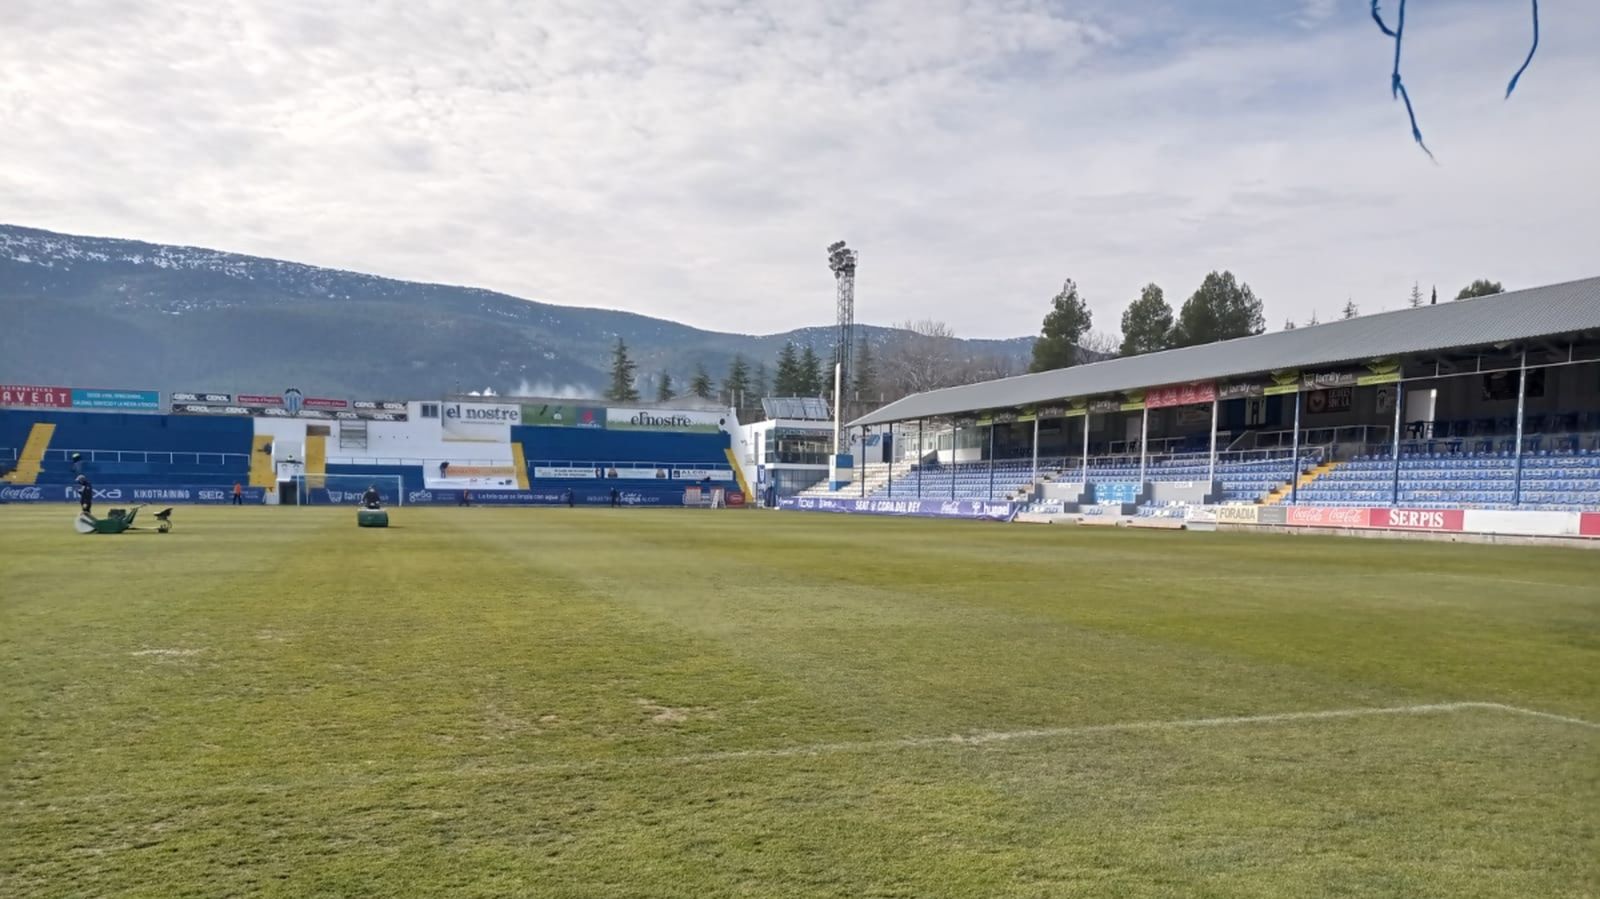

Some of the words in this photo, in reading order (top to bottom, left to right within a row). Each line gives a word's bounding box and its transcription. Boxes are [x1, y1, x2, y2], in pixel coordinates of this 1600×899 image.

[3, 391, 67, 404] AVENT
[446, 405, 461, 418] el
[466, 407, 519, 421] nostre
[133, 489, 191, 499] KIKOTRAINING
[198, 490, 225, 500] SER
[545, 495, 559, 503] agua
[1219, 507, 1257, 521] FORADIA
[1389, 509, 1444, 528] SERPIS
